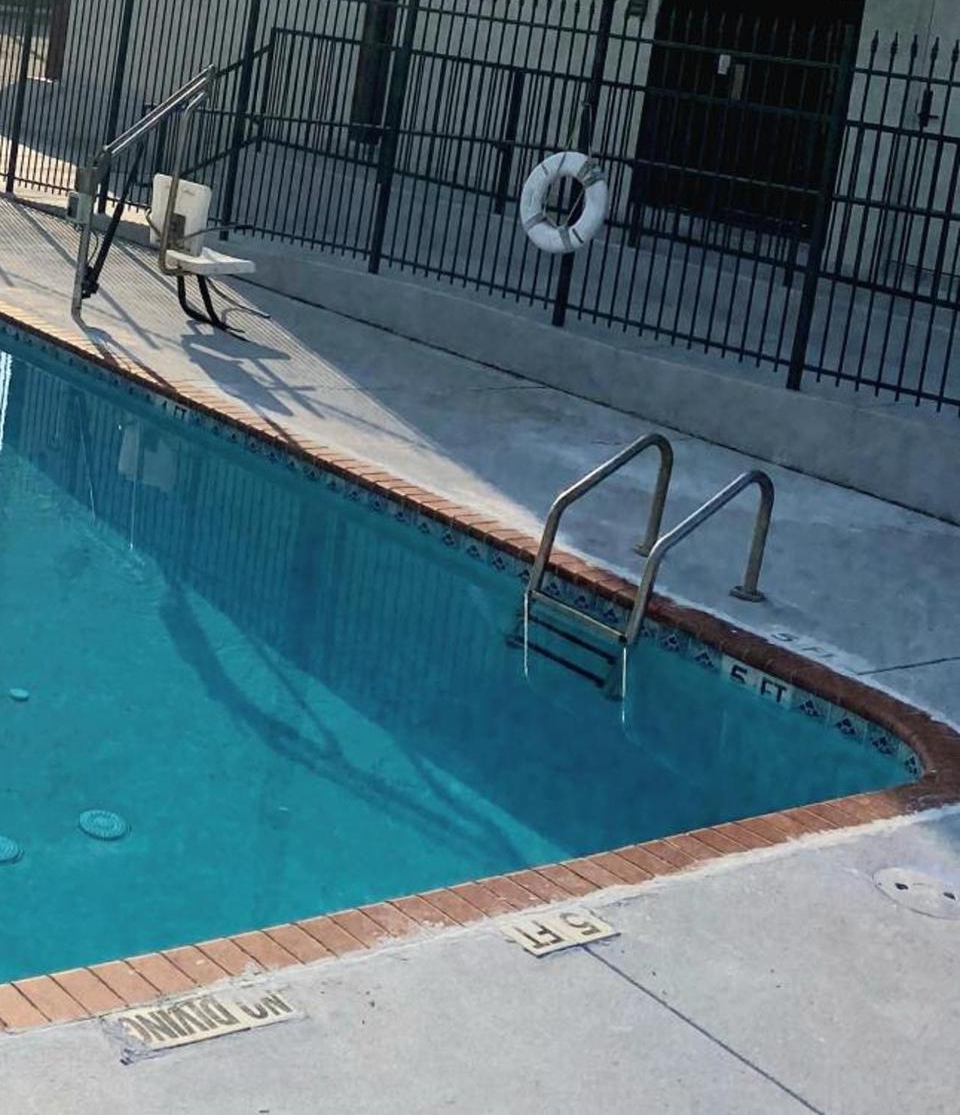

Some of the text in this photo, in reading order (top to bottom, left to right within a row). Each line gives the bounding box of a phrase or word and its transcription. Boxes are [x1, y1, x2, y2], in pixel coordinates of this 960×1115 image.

[730, 665, 787, 703] 5 FT
[515, 912, 602, 948] 5 FT
